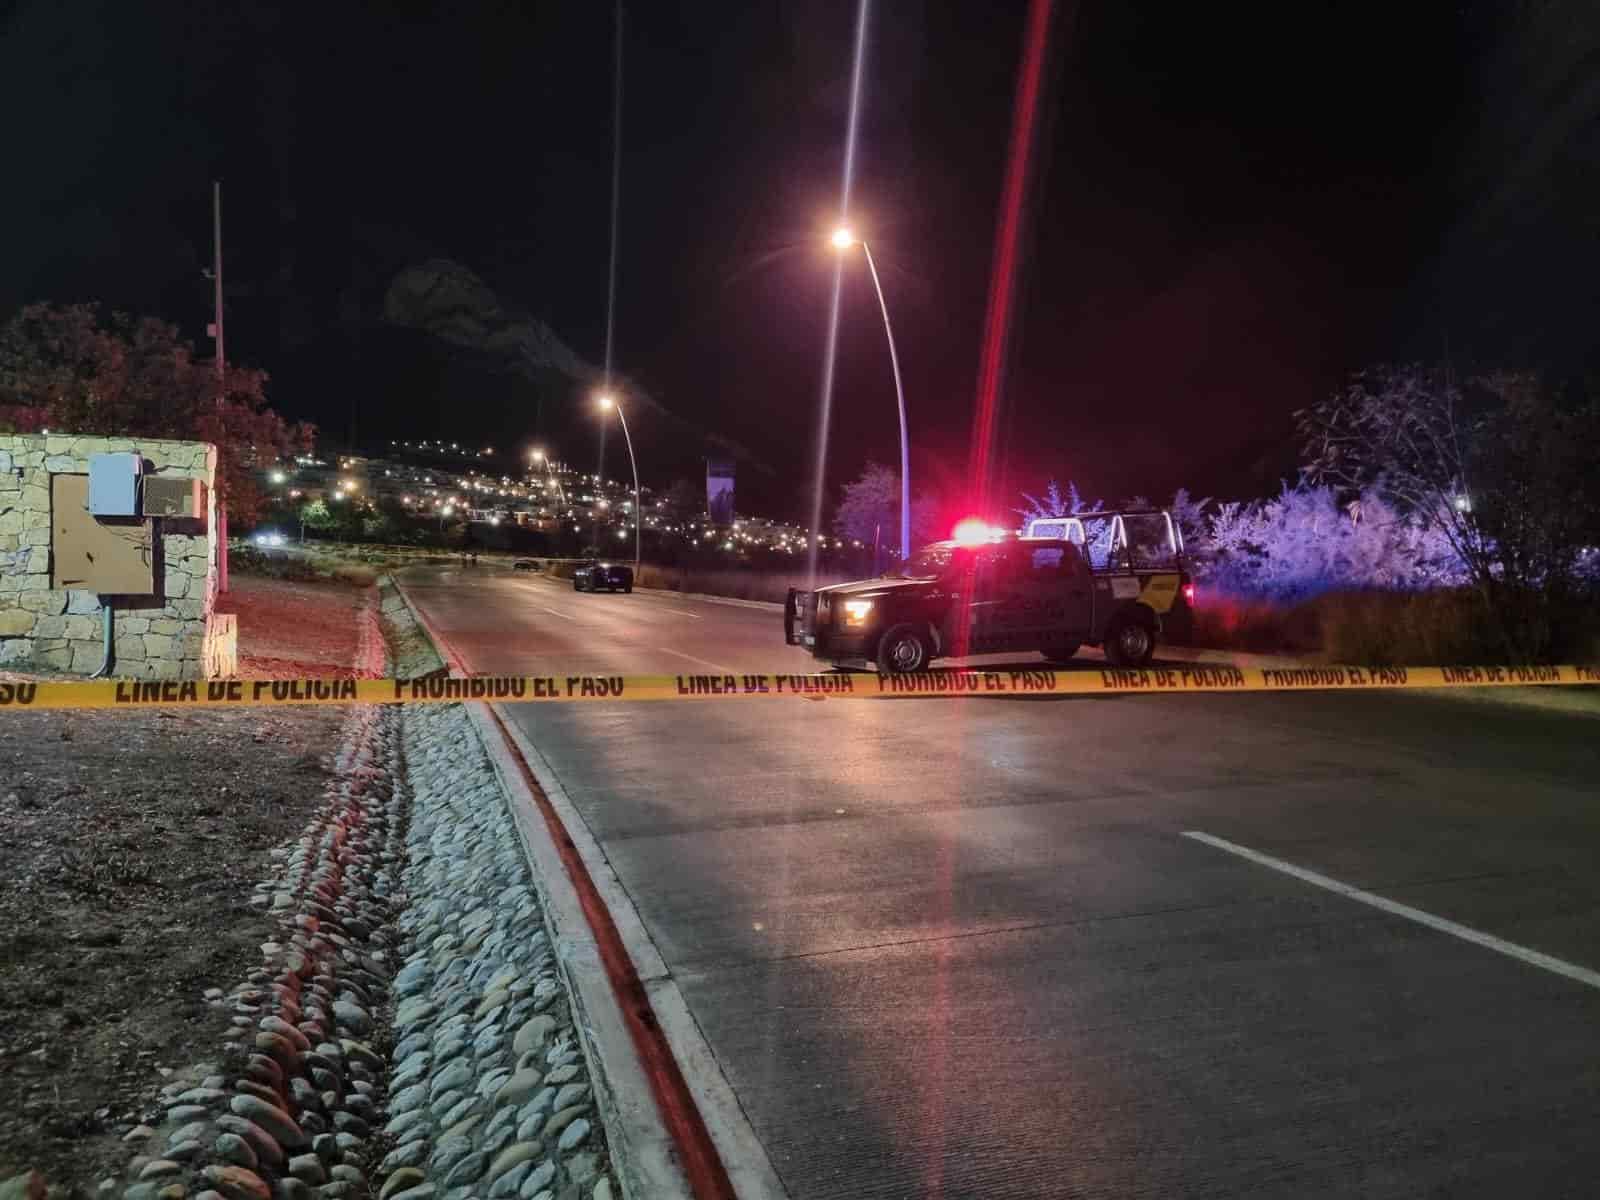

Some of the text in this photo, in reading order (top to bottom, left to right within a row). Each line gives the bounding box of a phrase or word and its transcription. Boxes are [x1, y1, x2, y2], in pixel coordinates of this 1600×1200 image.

[115, 680, 198, 703] LINEA
[208, 680, 242, 701] DE
[252, 679, 357, 701] POLICIA
[394, 676, 526, 698] PROHIBIDO
[533, 676, 559, 698] EL
[567, 676, 624, 697] PASO
[677, 674, 737, 695] LINEA
[743, 674, 769, 693] DE
[775, 673, 854, 693] POLICIA
[878, 672, 978, 692] PROHIBIDO
[985, 672, 1005, 690] EL
[1009, 671, 1056, 690] PASO
[1101, 669, 1150, 688] LINEA
[1155, 669, 1177, 687] DE
[1181, 667, 1245, 686] POLICIA
[1262, 667, 1344, 686] PROHIBIDO
[1347, 667, 1366, 684] EL
[1369, 667, 1406, 684] PASO
[1440, 665, 1483, 682] LINEA
[1487, 665, 1504, 682] DE
[1506, 665, 1560, 681] POLICIA
